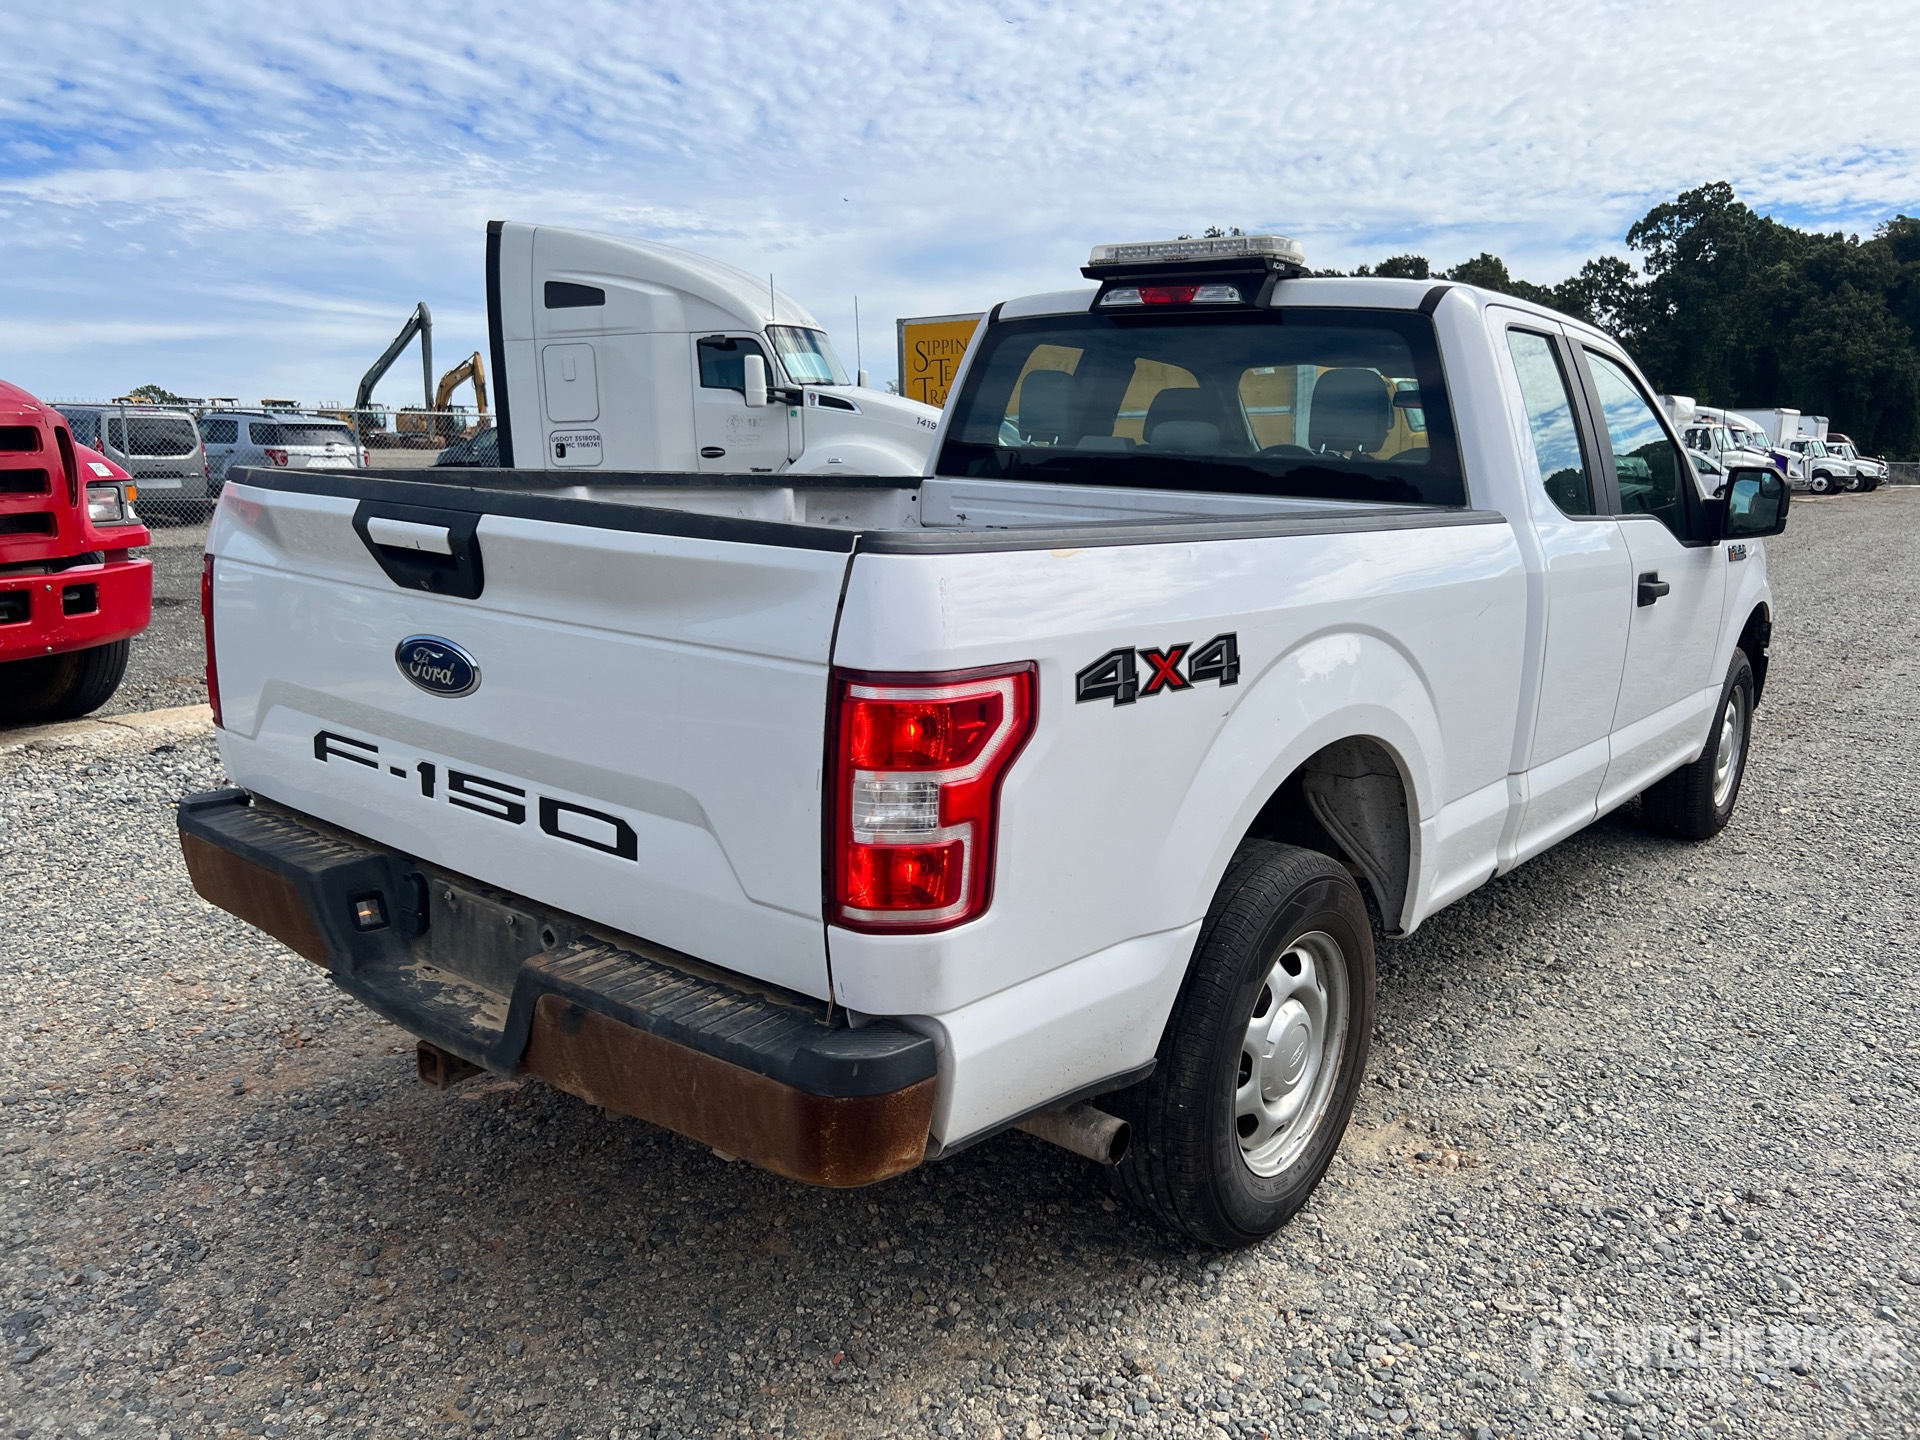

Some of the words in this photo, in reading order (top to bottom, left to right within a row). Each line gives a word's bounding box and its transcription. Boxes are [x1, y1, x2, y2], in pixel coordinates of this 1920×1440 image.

[916, 417, 938, 430] 1419
[410, 646, 455, 686] Ford
[313, 729, 639, 863] F-150
